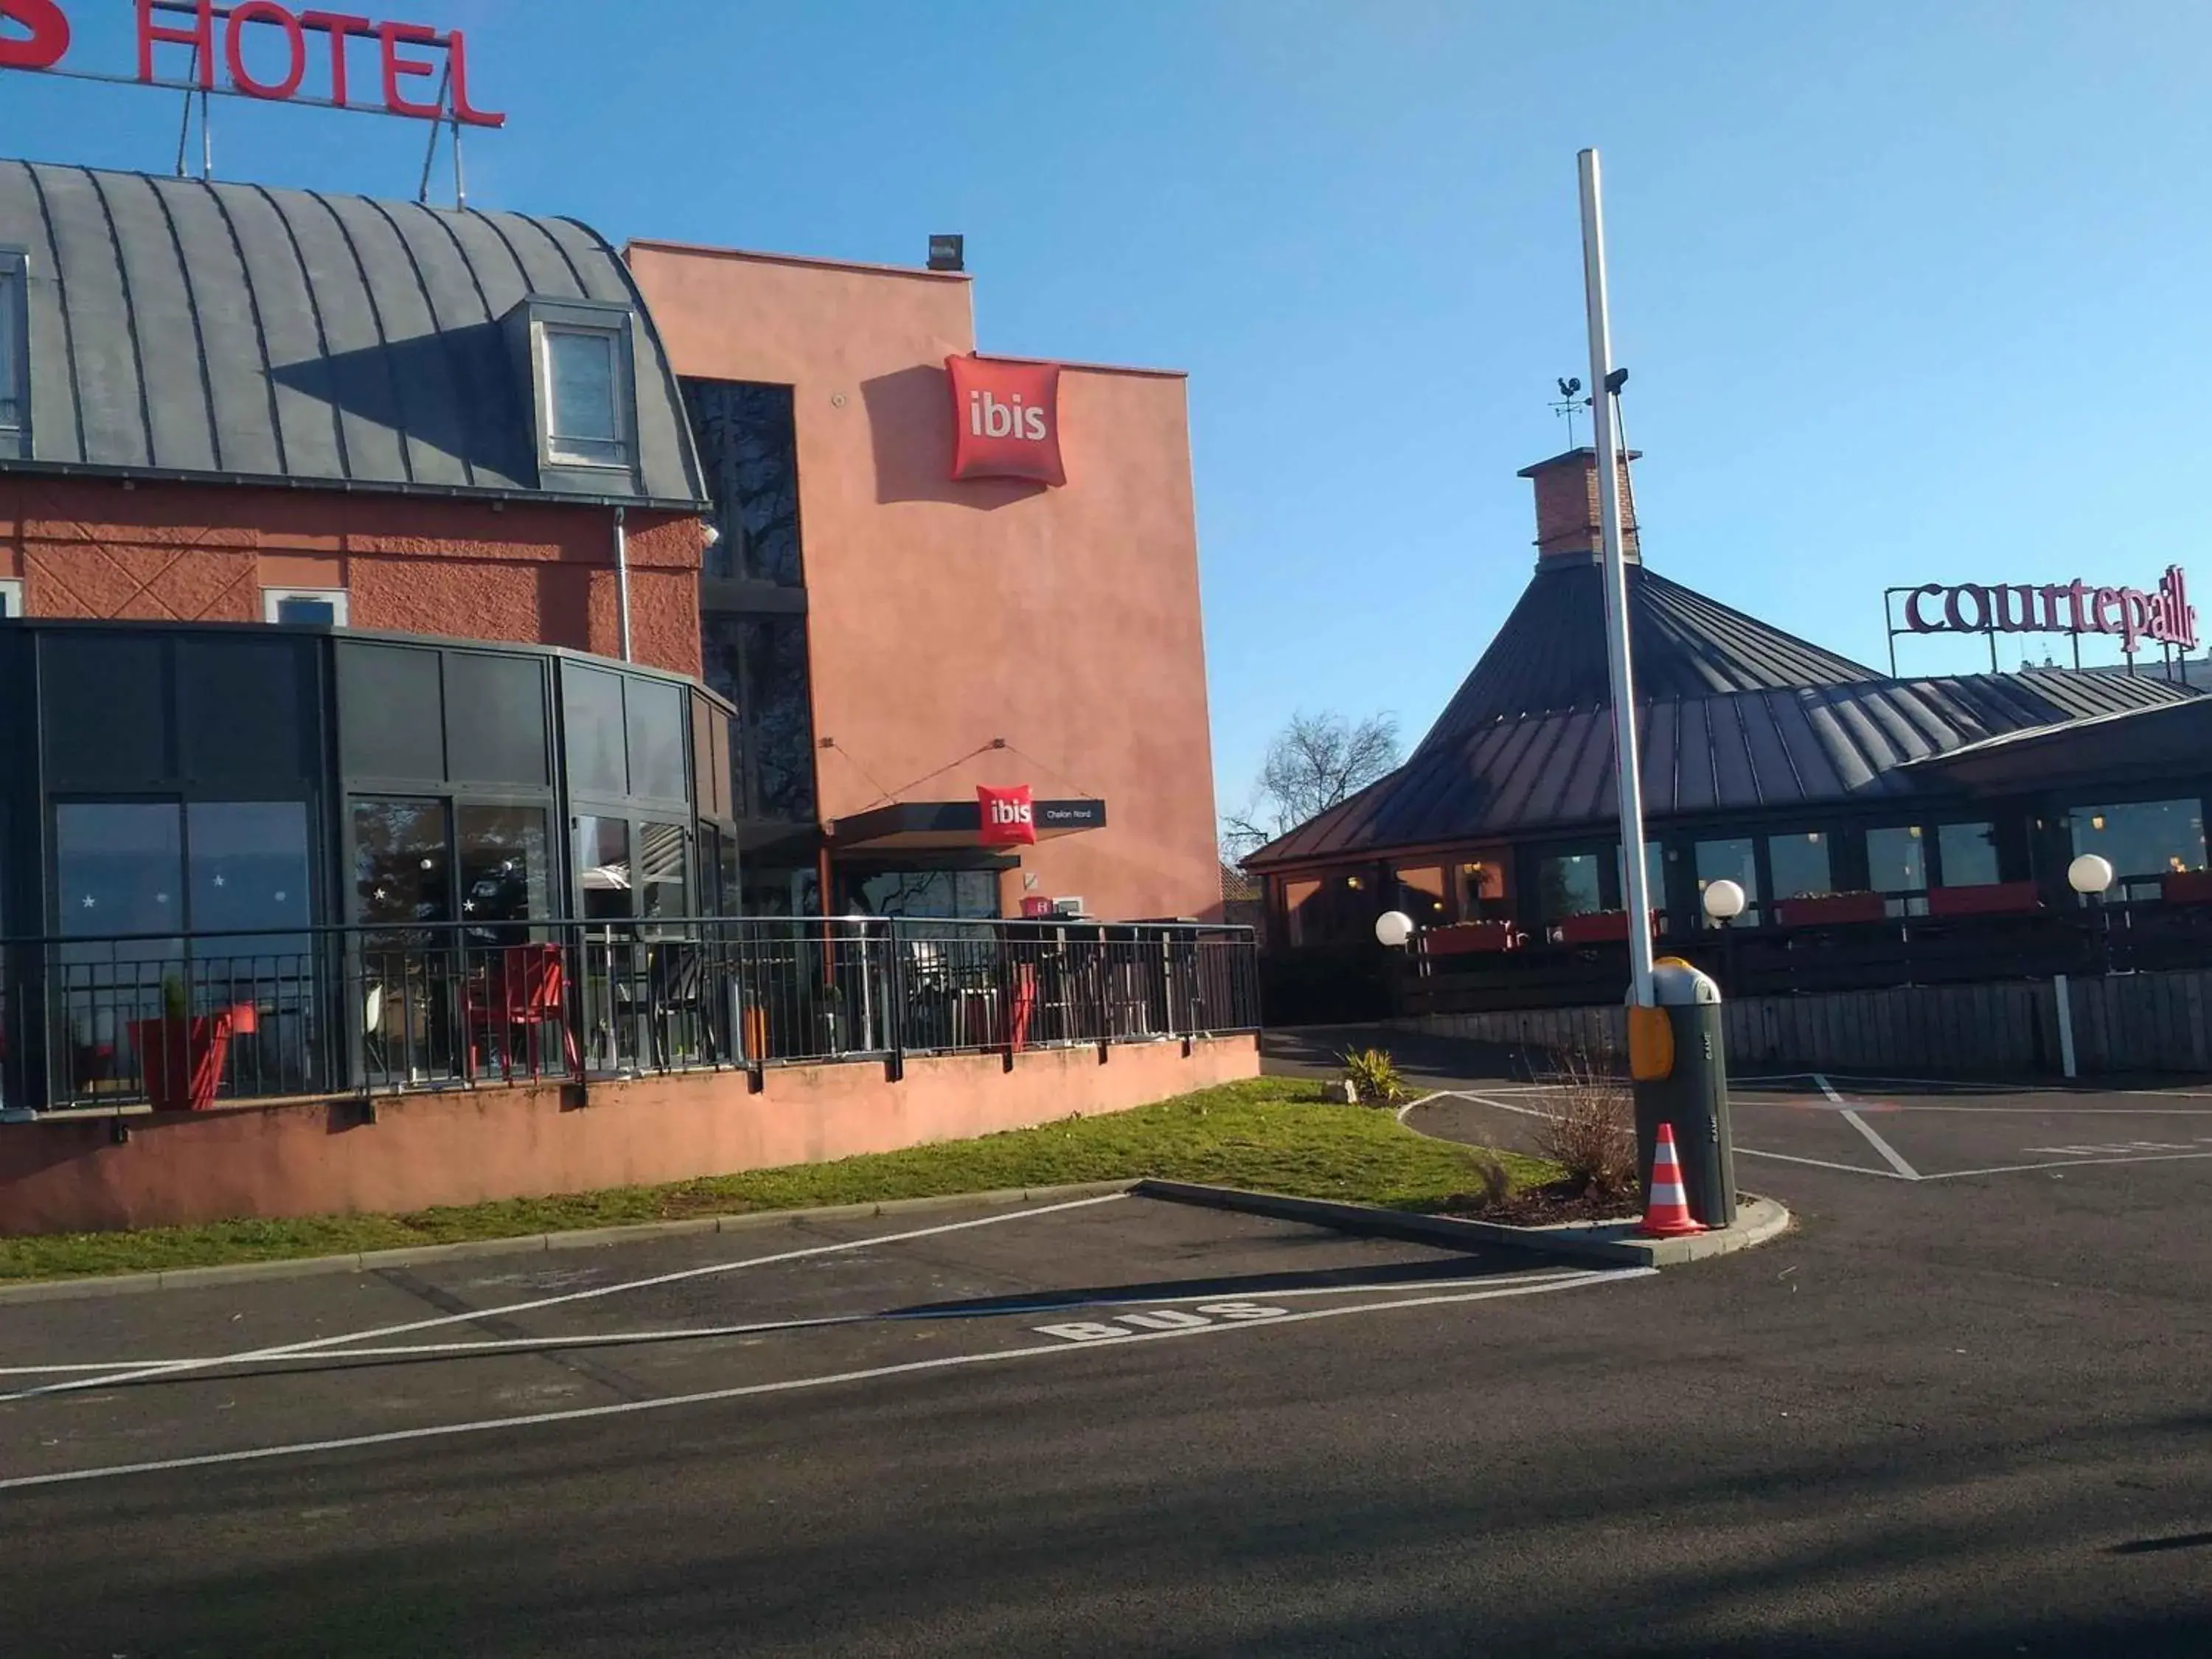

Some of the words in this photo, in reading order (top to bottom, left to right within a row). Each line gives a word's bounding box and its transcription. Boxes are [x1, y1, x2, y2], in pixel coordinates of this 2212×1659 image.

[136, 0, 506, 128] HOTEL
[970, 389, 1047, 441] ibis
[990, 799, 1032, 824] ibis
[1046, 810, 1072, 819] Chalon
[1074, 810, 1092, 818] Nord
[1032, 1302, 1290, 1342] BUS
